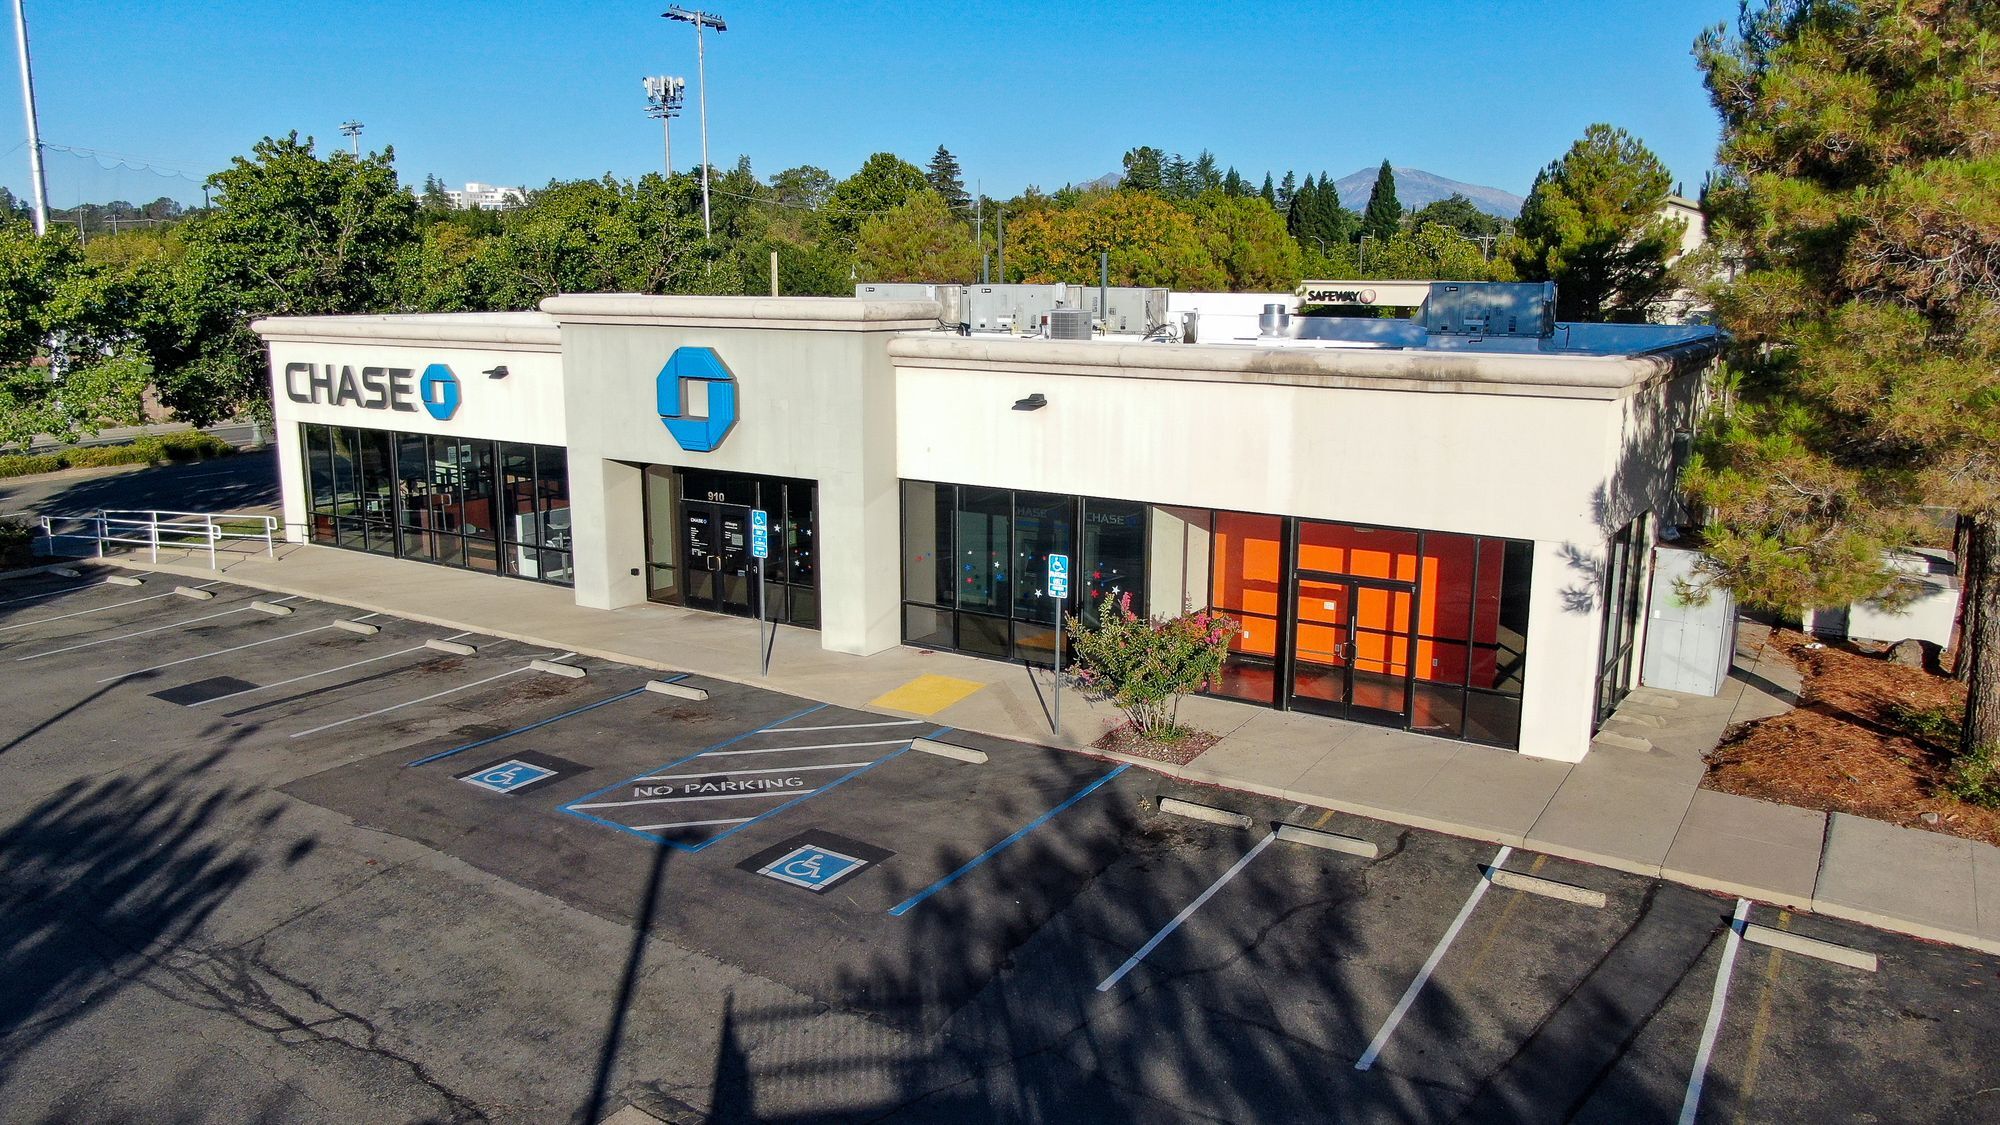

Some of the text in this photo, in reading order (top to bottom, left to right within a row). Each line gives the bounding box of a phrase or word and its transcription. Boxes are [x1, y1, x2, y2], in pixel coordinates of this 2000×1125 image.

[1307, 290, 1360, 302] SAFEWAY
[285, 362, 419, 412] CHASE
[707, 491, 725, 502] 910
[1016, 506, 1047, 518] HASE
[1085, 511, 1125, 525] CHASE
[634, 777, 804, 798] NO PARKING
